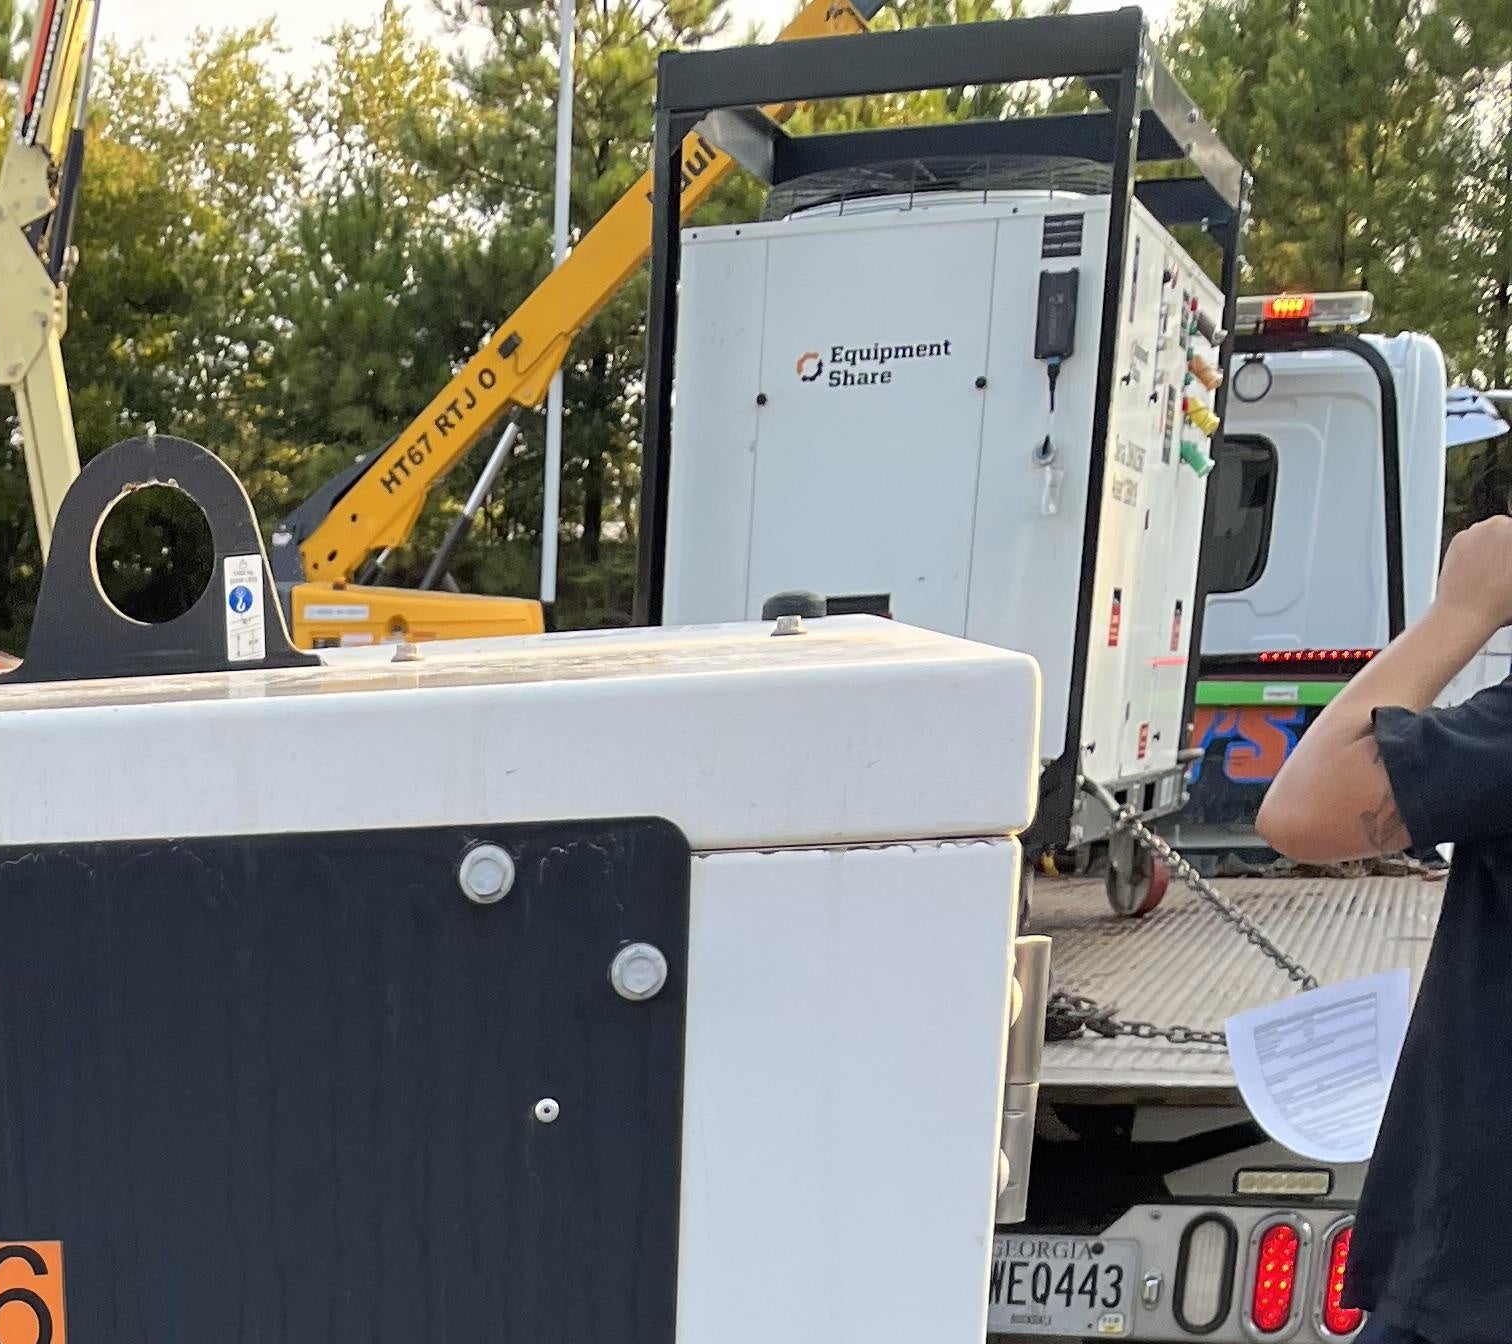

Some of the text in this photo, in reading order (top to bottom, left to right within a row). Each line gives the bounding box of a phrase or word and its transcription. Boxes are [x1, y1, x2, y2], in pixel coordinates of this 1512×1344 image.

[830, 338, 952, 366] Equipment
[828, 369, 893, 388] Share
[379, 431, 435, 495] HT67
[433, 387, 478, 438] RTJ
